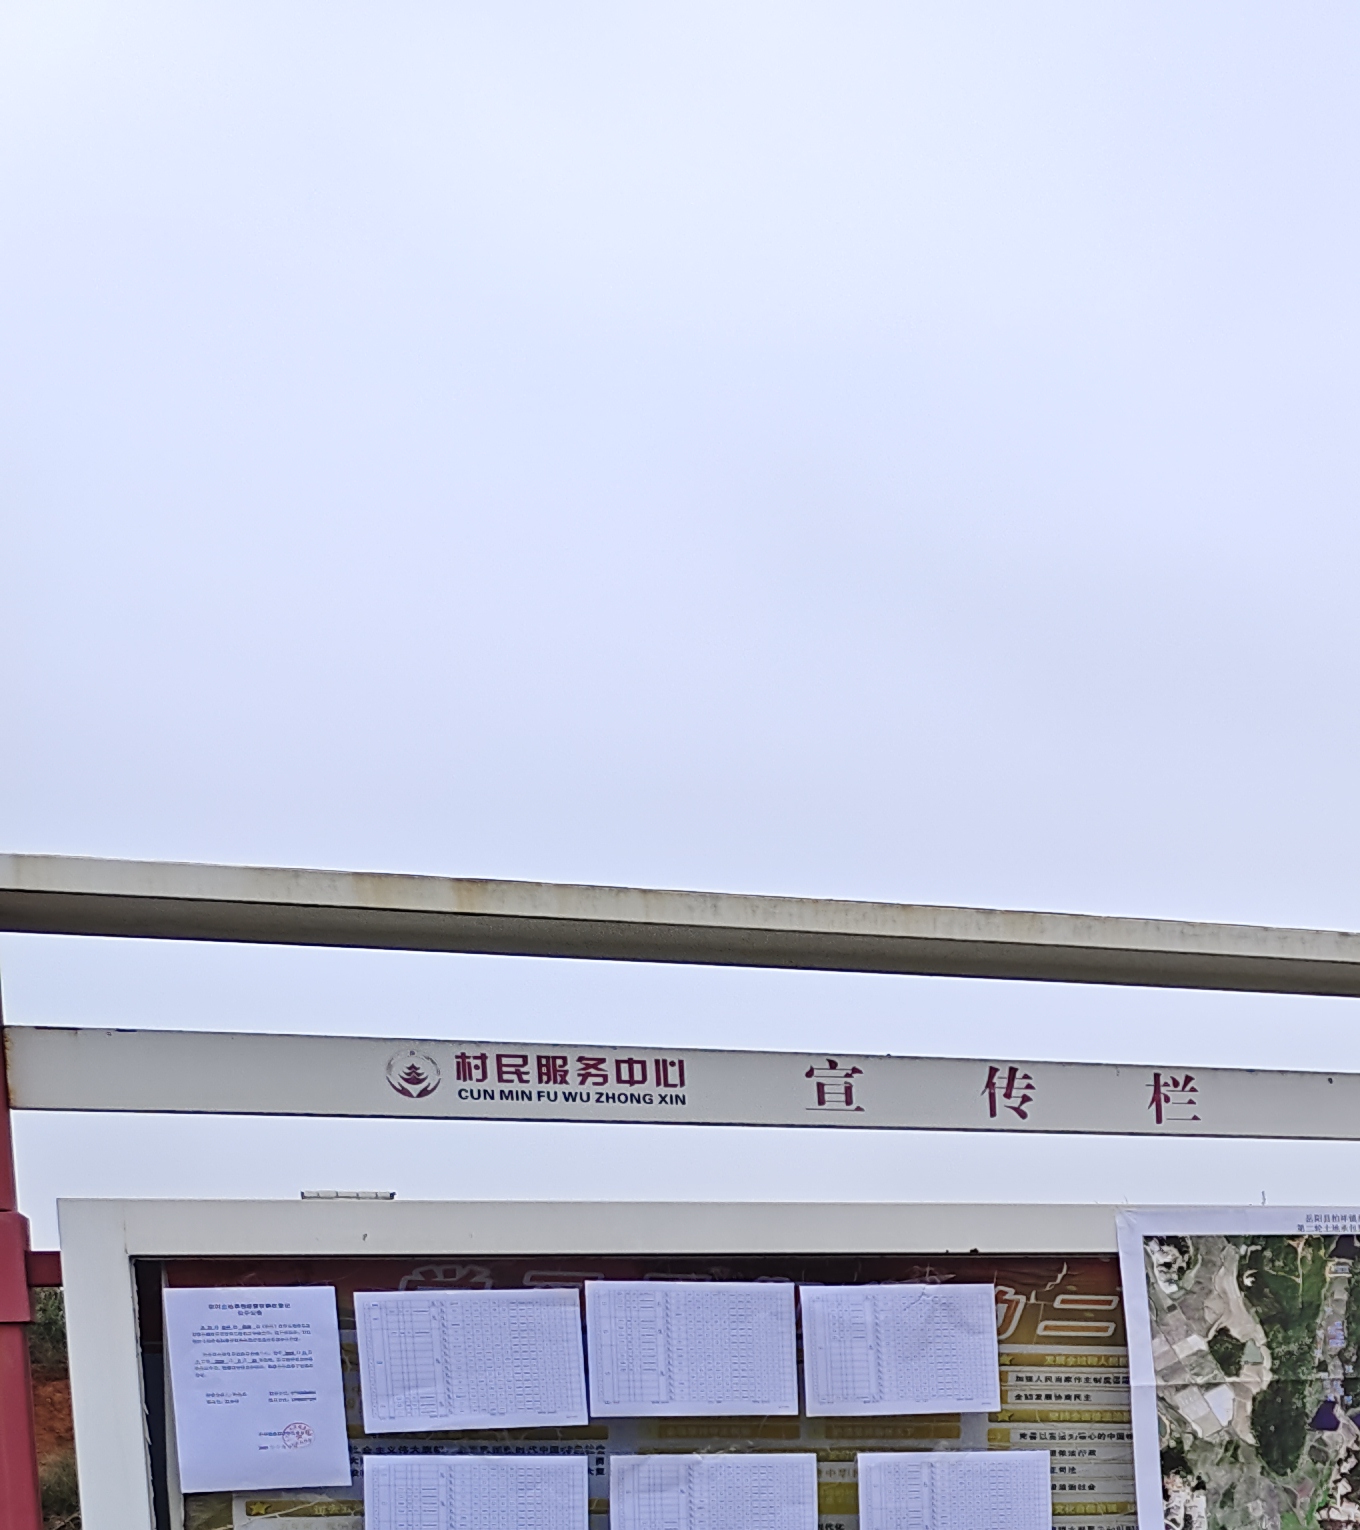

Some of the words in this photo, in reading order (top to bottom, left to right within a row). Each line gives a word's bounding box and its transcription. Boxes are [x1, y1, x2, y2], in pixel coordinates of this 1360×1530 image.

[454, 1051, 686, 1088] 村民服务中心
[457, 1088, 497, 1101] CUN
[500, 1089, 532, 1102] MIN
[538, 1090, 559, 1103] FU
[563, 1091, 591, 1104] WU
[595, 1092, 654, 1105] ZHONG
[658, 1093, 686, 1106] XIN
